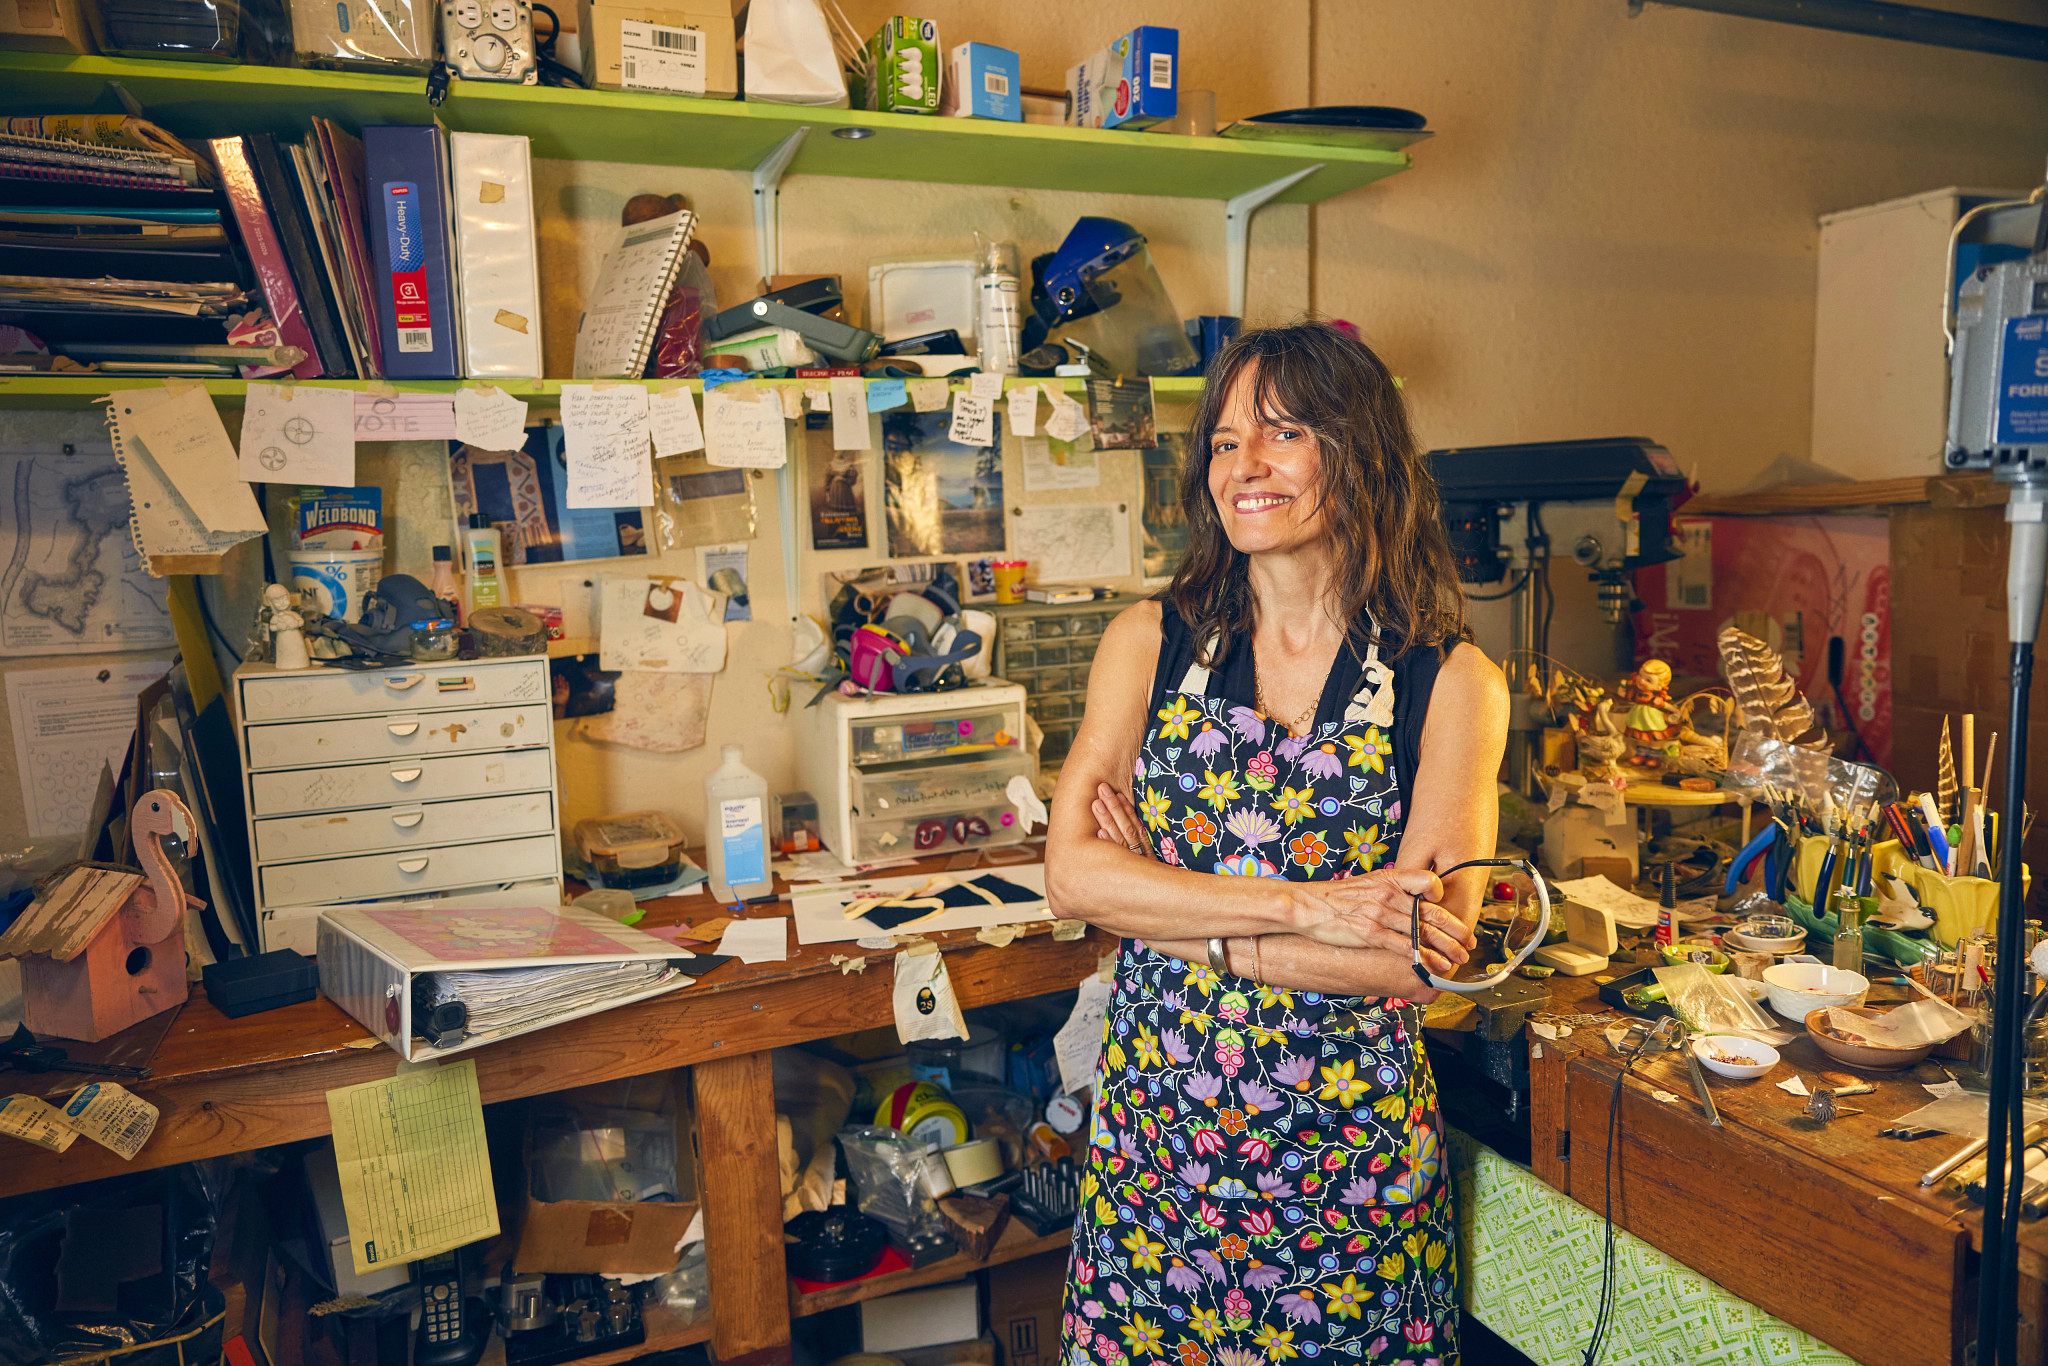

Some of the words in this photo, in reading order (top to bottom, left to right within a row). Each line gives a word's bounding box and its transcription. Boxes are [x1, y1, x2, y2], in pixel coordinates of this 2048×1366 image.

[927, 86, 937, 107] LED
[1133, 76, 1141, 103] 200
[396, 200, 410, 262] Heavy-Duty
[306, 500, 377, 530] WELDBOND
[724, 804, 745, 812] equate
[919, 999, 934, 1011] 28
